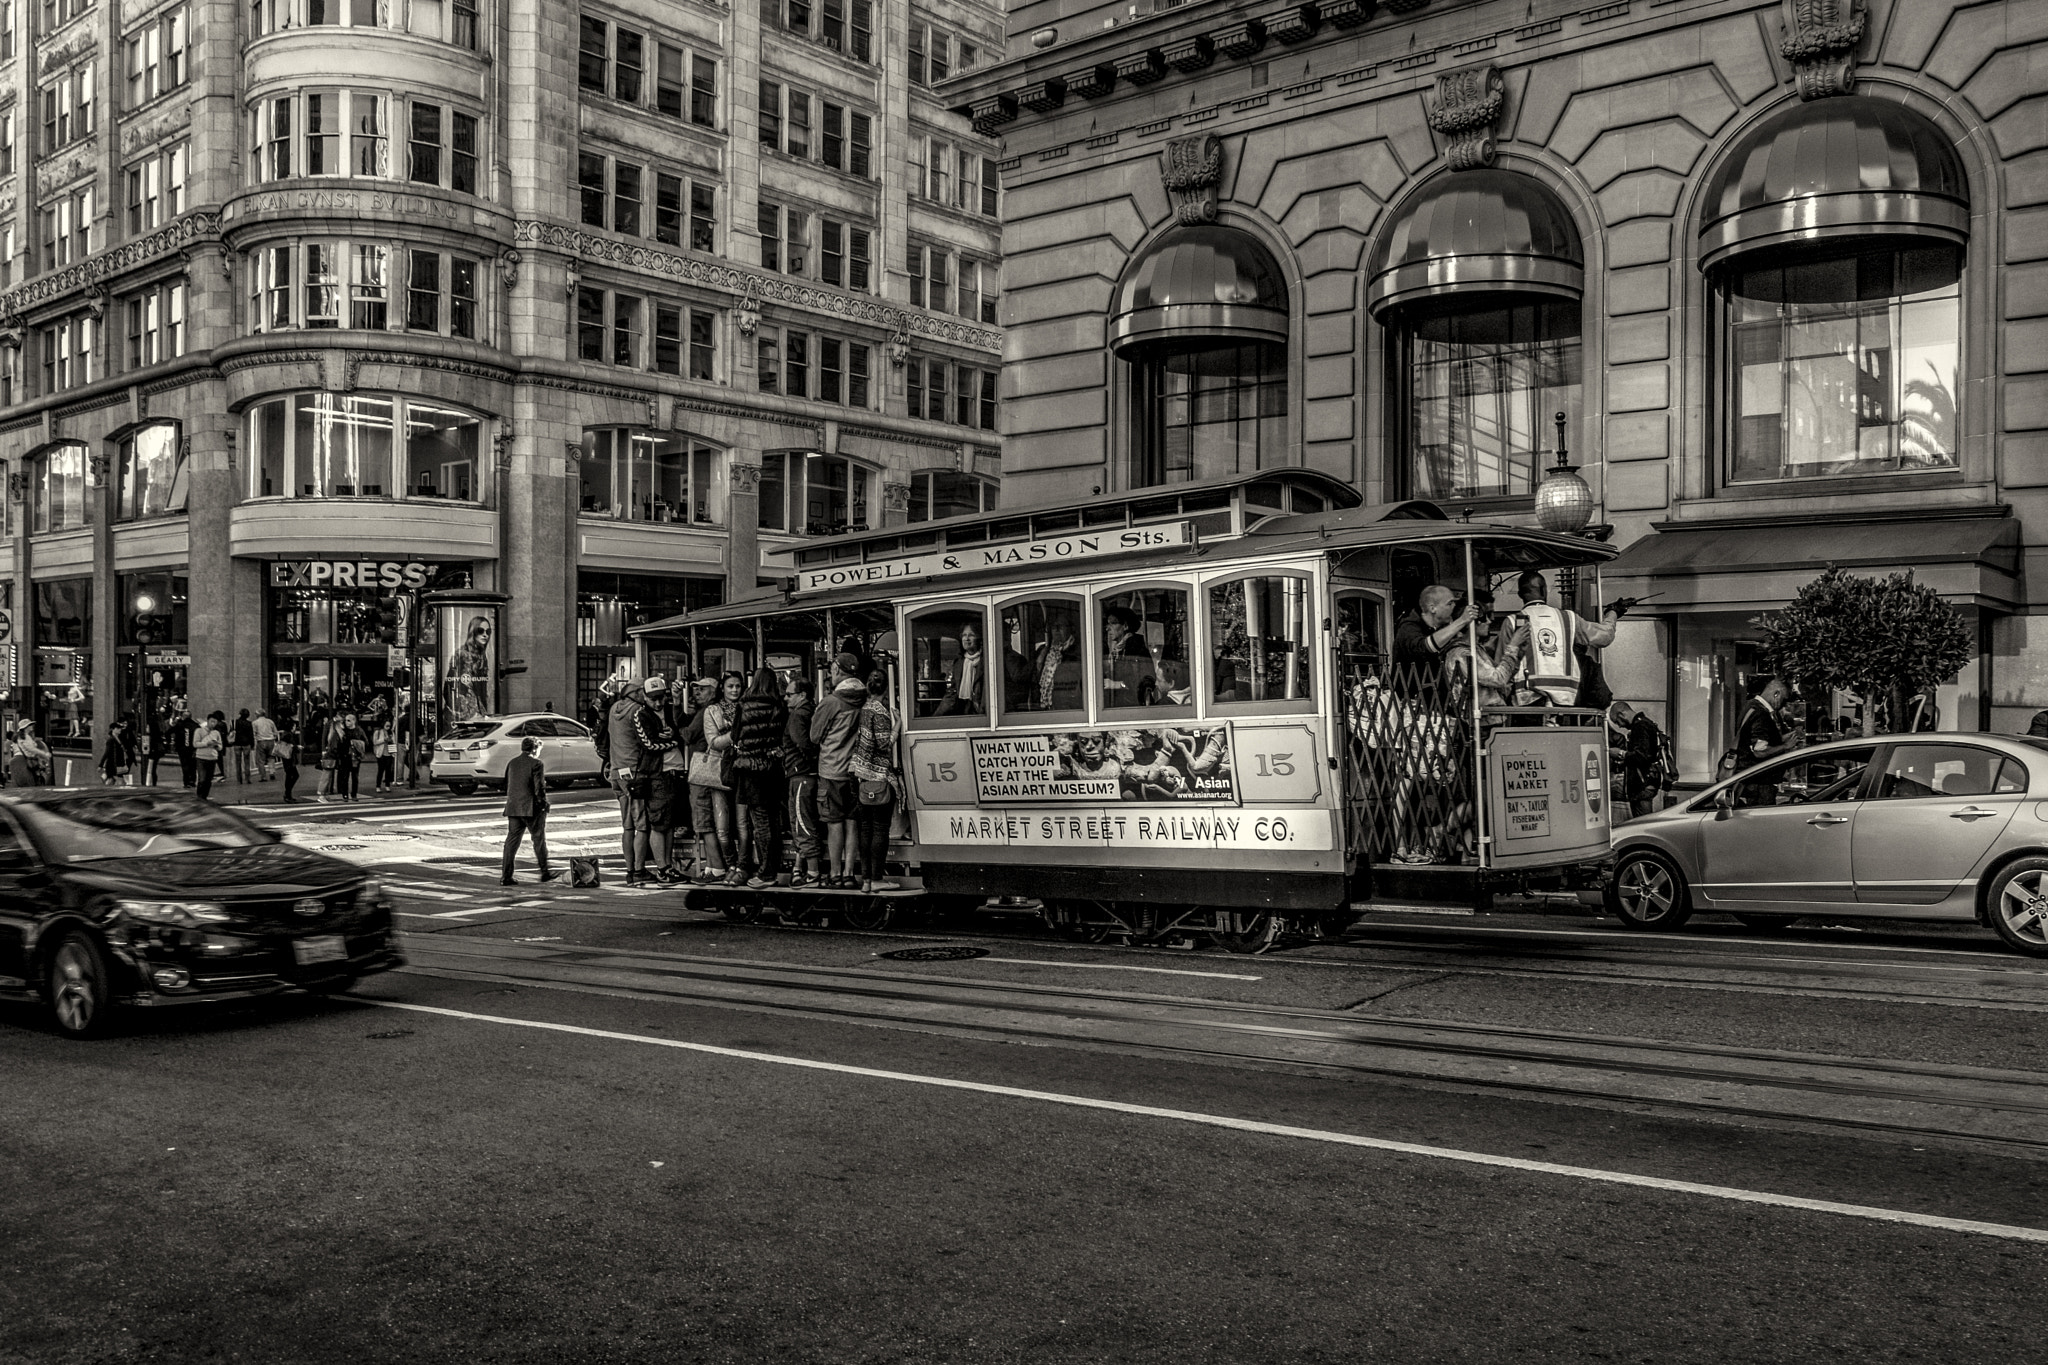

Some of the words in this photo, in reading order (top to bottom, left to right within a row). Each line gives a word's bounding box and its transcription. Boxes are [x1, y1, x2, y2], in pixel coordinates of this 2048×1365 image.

[811, 562, 921, 588] POWELL
[942, 556, 962, 571] &
[984, 537, 1100, 566] MASON
[1119, 530, 1171, 554] Sts.
[271, 561, 427, 588] EXPRESS
[976, 742, 1011, 754] WHAT
[1014, 741, 1045, 753] WILL
[978, 756, 1018, 768] CATCH
[1020, 755, 1055, 767] YOUR
[1254, 752, 1296, 777] 15
[1506, 760, 1547, 771] POWELL
[927, 761, 958, 783] 15
[980, 771, 1004, 782] EYE
[1006, 770, 1021, 782] AT
[1023, 770, 1050, 781] THE
[1518, 771, 1538, 779] AND
[1195, 776, 1231, 789] Asian
[1507, 779, 1549, 791] MARKET
[982, 785, 1019, 796] ASIAN
[1022, 784, 1046, 796] ART
[1049, 783, 1115, 795] MUSEUM?
[1176, 791, 1232, 800] www.asianart.org
[1560, 779, 1581, 804] 15
[1507, 801, 1519, 813] BAY
[1528, 800, 1549, 811] TAYLOR
[950, 816, 1032, 840] MARKET
[1041, 817, 1128, 841] STREET
[1138, 817, 1242, 843] RAILWAY
